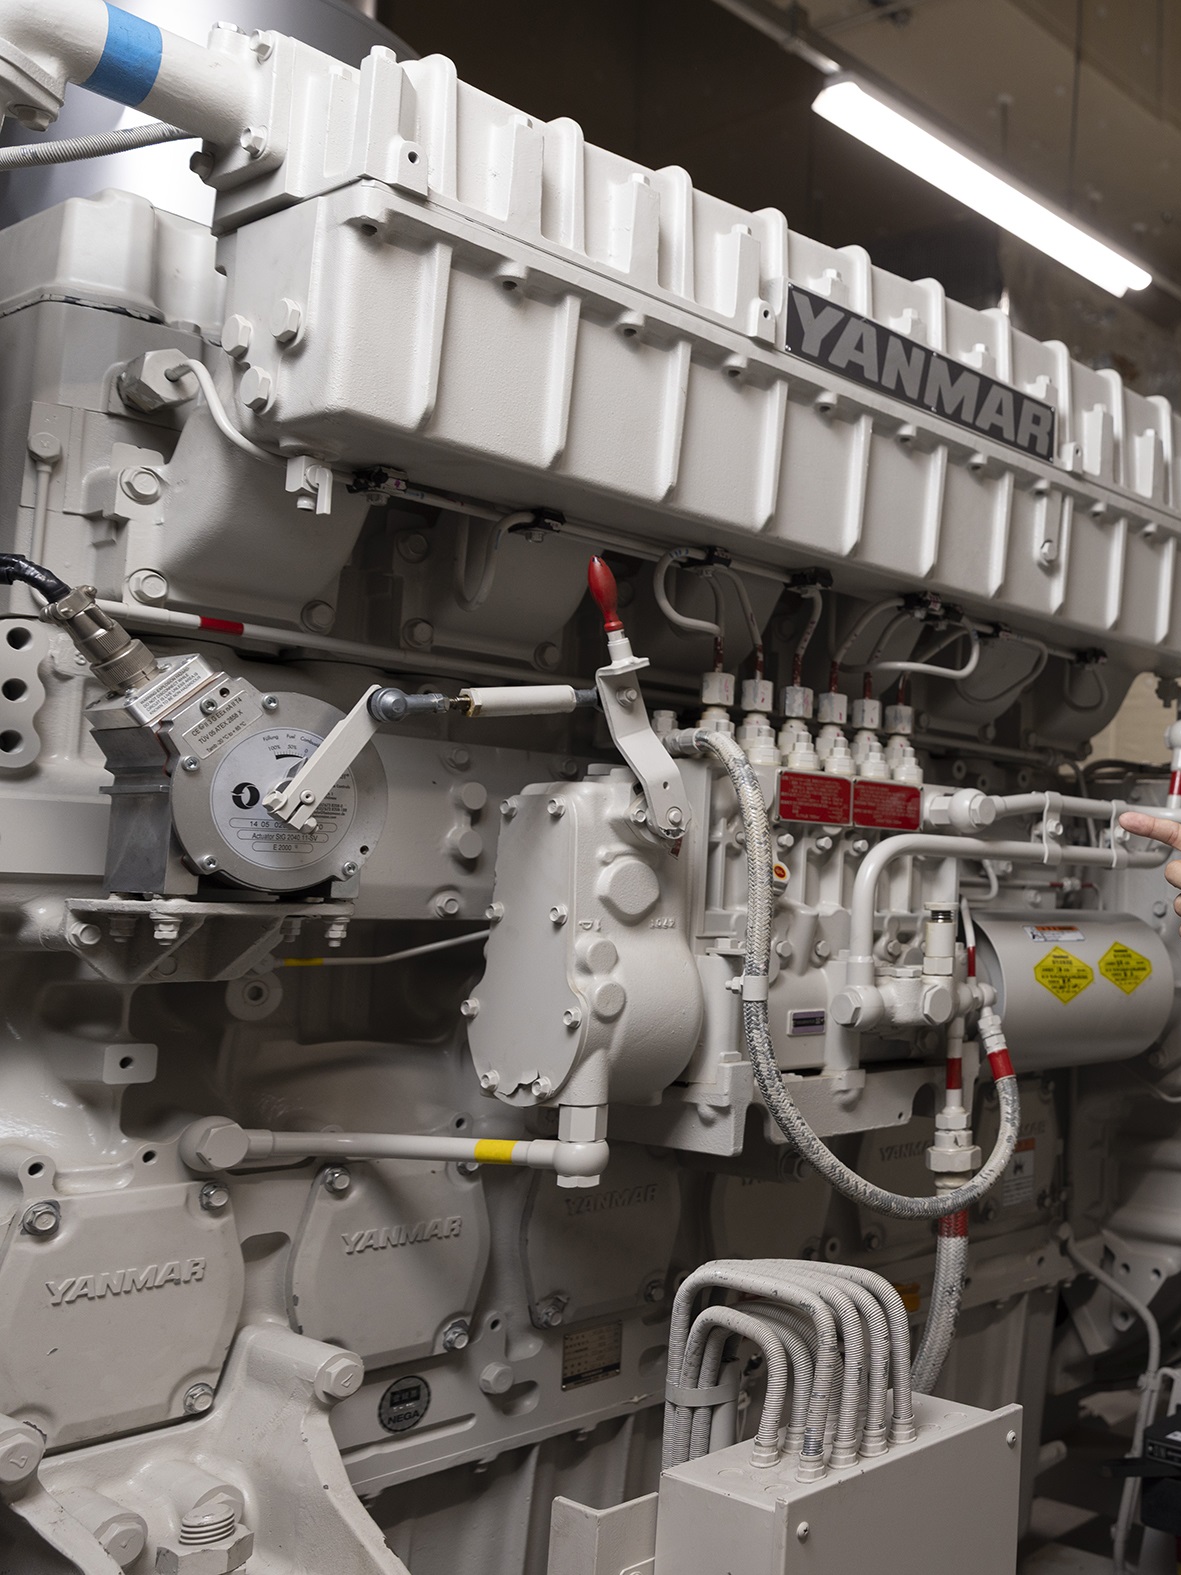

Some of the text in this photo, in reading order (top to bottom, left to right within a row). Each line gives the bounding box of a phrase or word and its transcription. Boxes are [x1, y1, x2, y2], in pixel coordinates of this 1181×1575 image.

[791, 290, 1051, 456] YANMAR
[190, 727, 200, 737] CE
[234, 696, 242, 704] T4
[197, 732, 210, 744] TÜV
[213, 720, 228, 733] ATEX
[341, 1215, 462, 1255] YANMAR
[45, 1257, 207, 1306] YANMAR
[388, 1410, 420, 1425] NEGA
